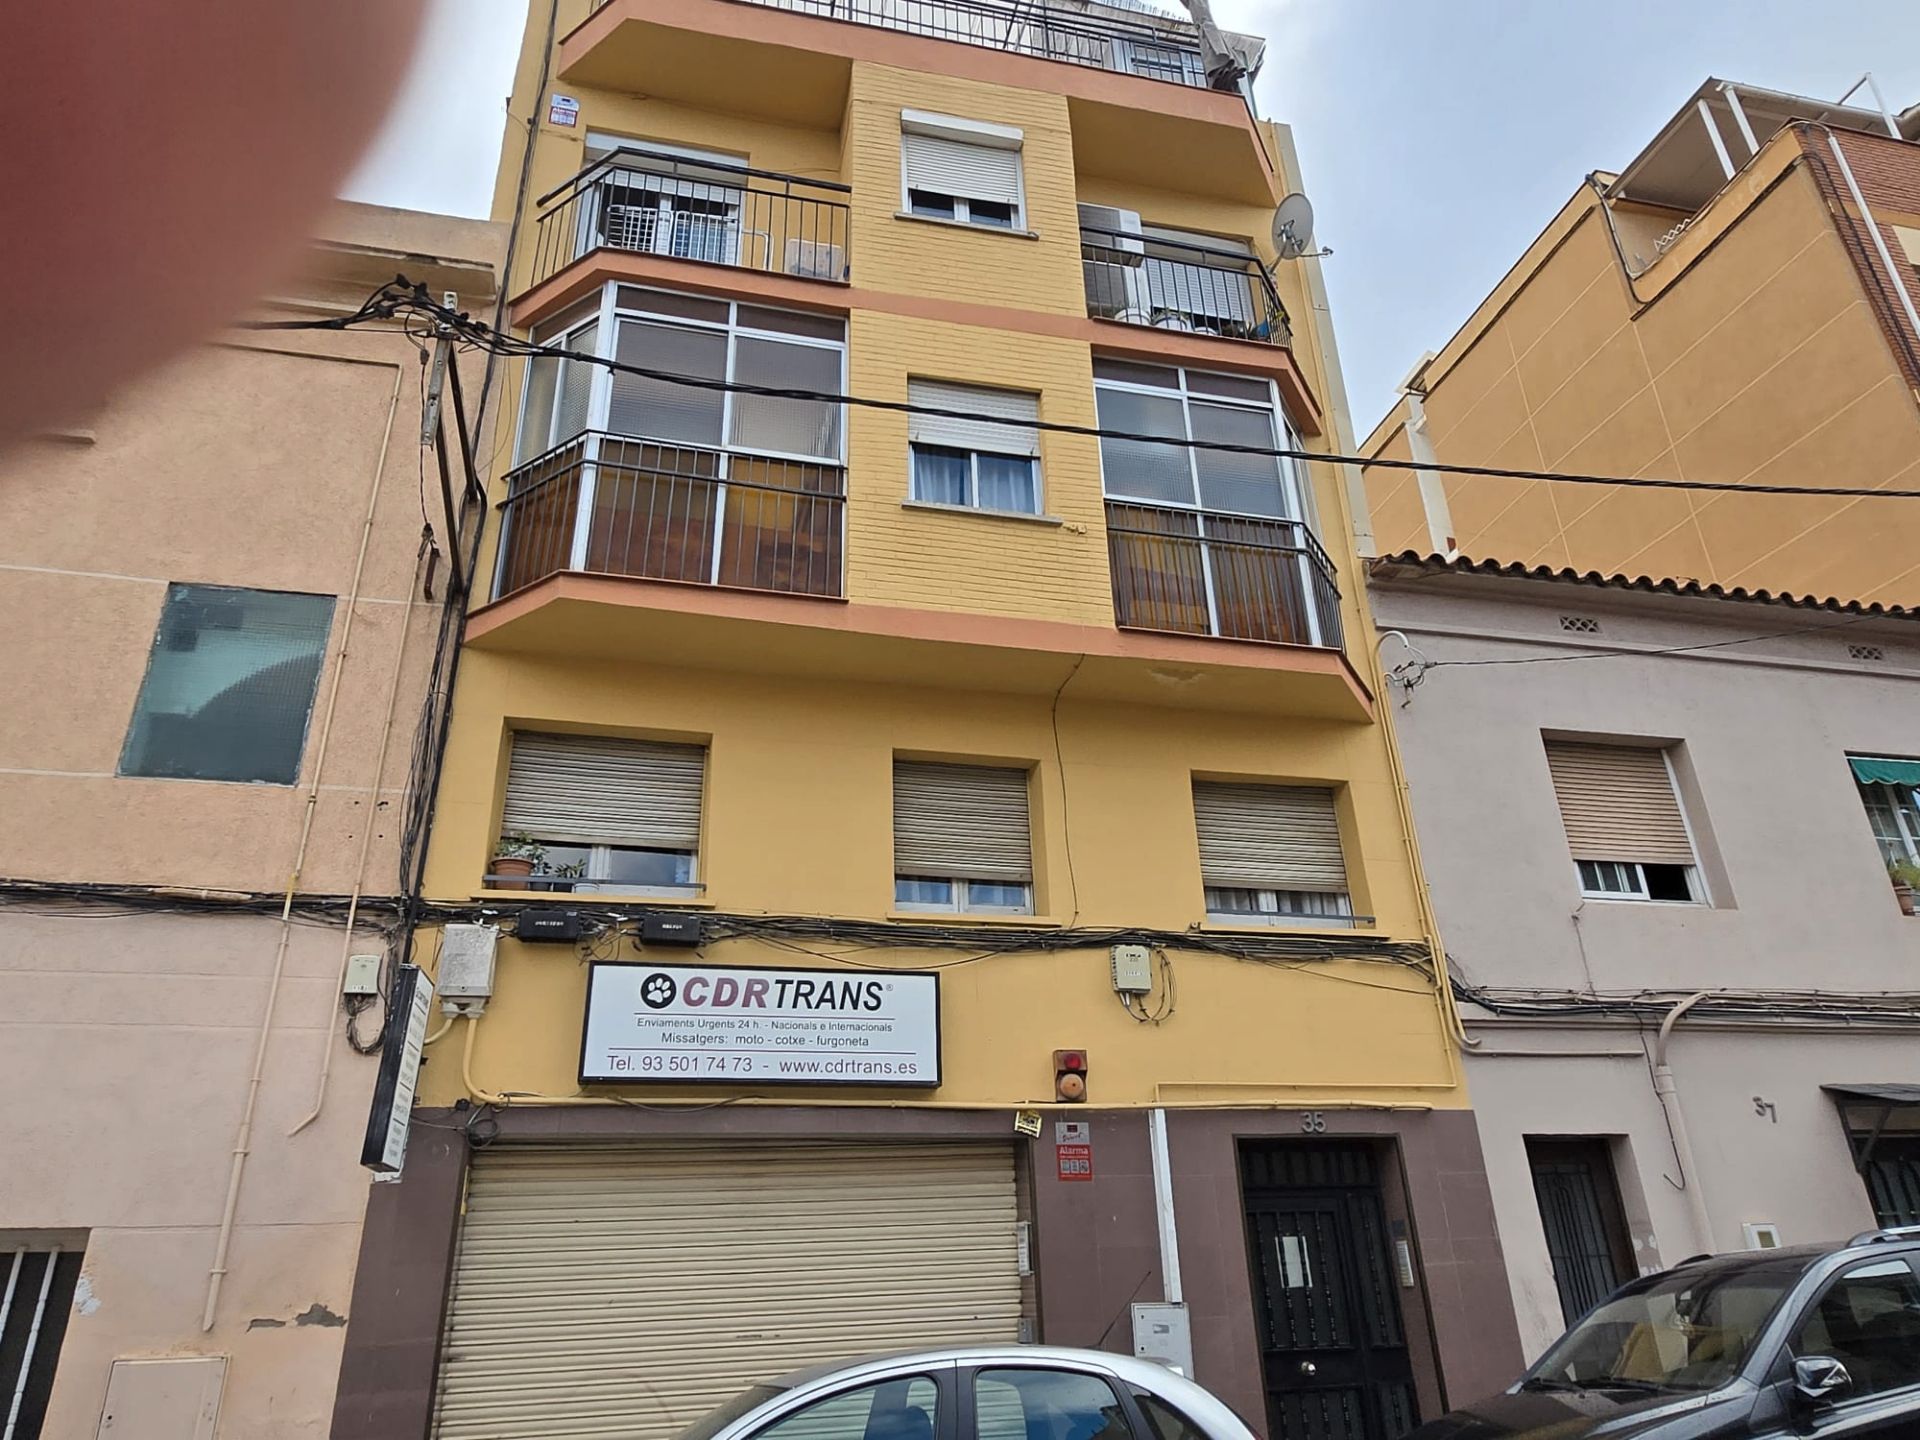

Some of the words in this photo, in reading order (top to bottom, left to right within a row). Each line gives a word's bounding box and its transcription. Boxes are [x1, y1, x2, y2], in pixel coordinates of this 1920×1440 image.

[637, 1018, 695, 1028] Enviaments
[697, 1019, 736, 1030] Urgents
[737, 1019, 750, 1028] 24
[771, 1021, 817, 1030] Nacionals
[828, 1022, 893, 1032] Internacionals
[661, 1033, 728, 1046] Missatgers:
[735, 1034, 764, 1045] moto
[775, 1036, 806, 1046] cotxe
[816, 1035, 869, 1048] furgoneta
[607, 1055, 636, 1071] Tel.
[642, 1056, 663, 1071] 93
[669, 1056, 699, 1071] 501
[706, 1057, 726, 1072] 74
[732, 1057, 752, 1072] 73
[779, 1058, 917, 1074] www.cdrtrans.es
[1752, 1096, 1777, 1123] 37
[1302, 1112, 1327, 1133] 35
